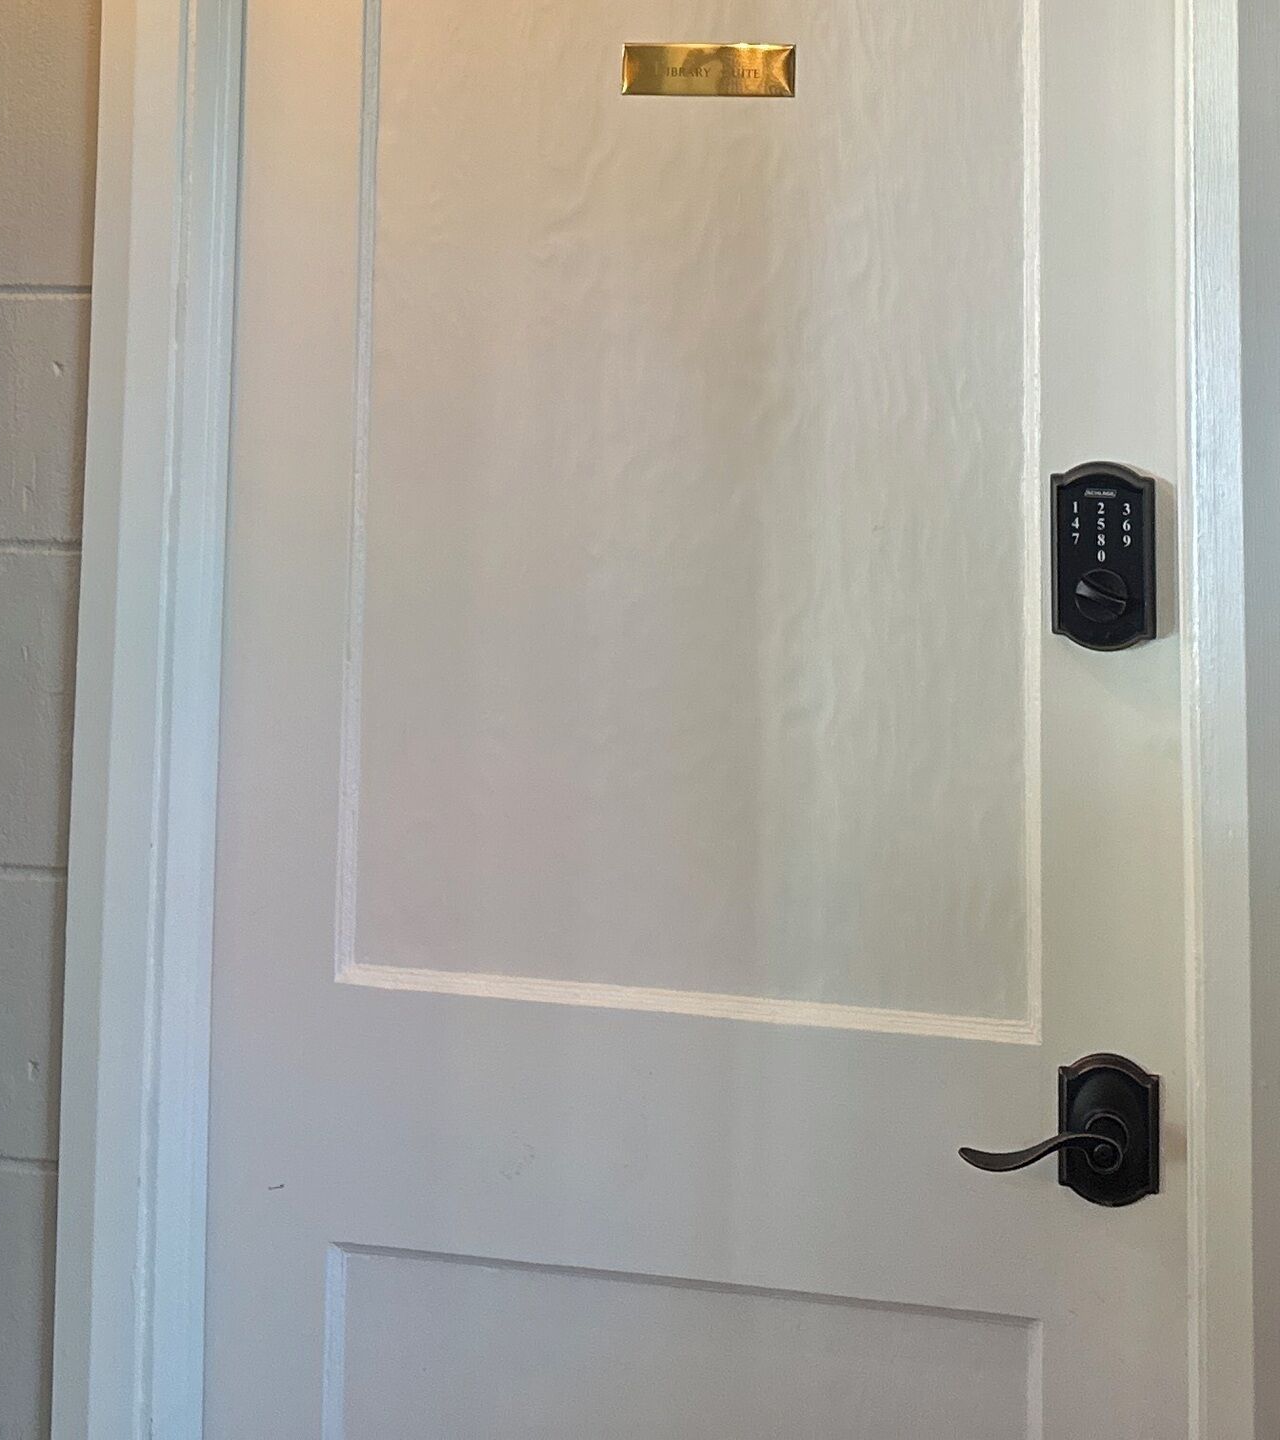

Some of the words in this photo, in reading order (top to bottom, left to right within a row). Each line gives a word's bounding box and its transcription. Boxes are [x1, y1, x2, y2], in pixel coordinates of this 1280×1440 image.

[1072, 501, 1078, 514] 1
[1097, 502, 1106, 515] 2
[1122, 503, 1131, 516] 3
[1071, 517, 1080, 529] 4
[1097, 518, 1106, 530] 5
[1122, 519, 1131, 531] 6
[1072, 533, 1080, 545] 7
[1097, 534, 1106, 546] 8
[1122, 535, 1131, 547] 9
[1097, 549, 1106, 562] 0
